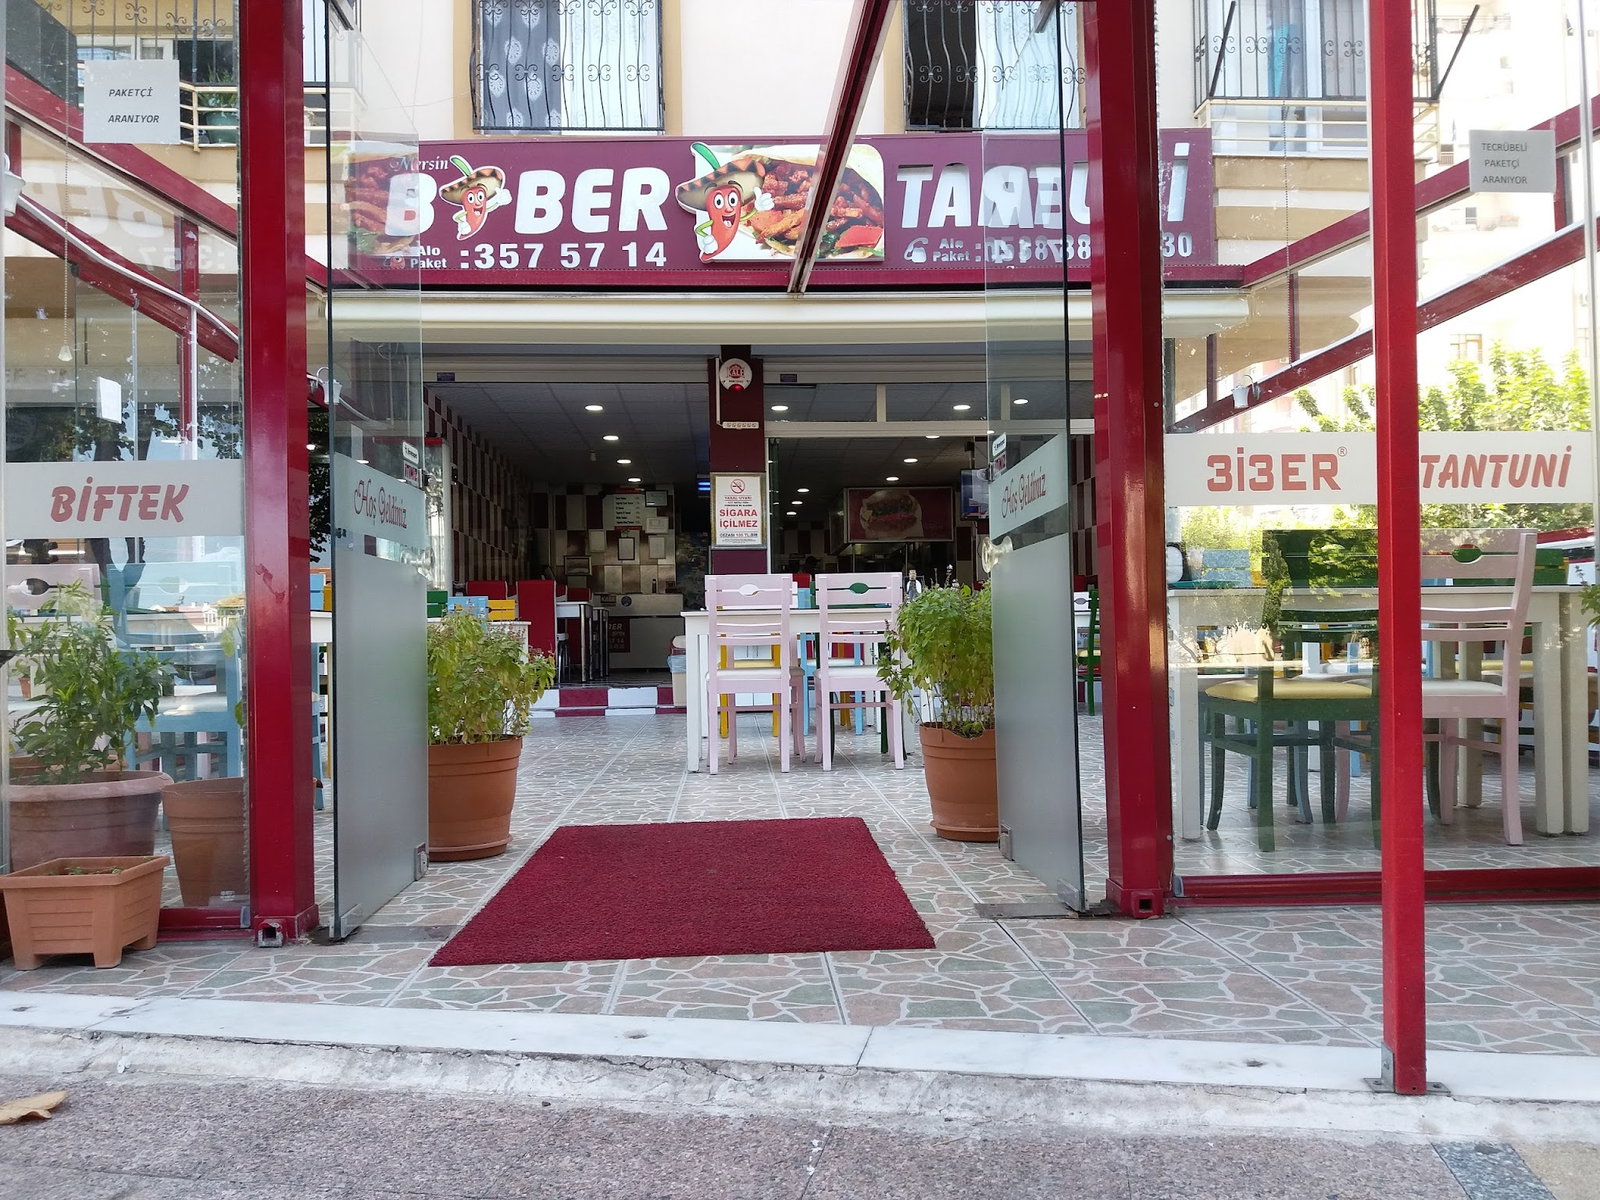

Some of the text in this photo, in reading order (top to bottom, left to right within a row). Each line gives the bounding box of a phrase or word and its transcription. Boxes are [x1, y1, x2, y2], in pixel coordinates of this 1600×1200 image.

[108, 85, 153, 98] PAKETÇİ
[107, 114, 160, 123] ARANIYOR
[1481, 141, 1528, 152] TECRÜBELİ
[388, 156, 449, 171] Mersin
[1484, 157, 1520, 169] PAKETÇİ
[1482, 175, 1528, 184] ARANIYOR
[939, 238, 963, 249] Alo
[417, 245, 441, 256] Alo
[560, 243, 605, 268] 57
[622, 242, 667, 267] 14
[933, 251, 970, 262] Paket
[410, 258, 447, 268] Paket
[1420, 444, 1572, 489] TANTUNİ
[50, 476, 190, 523] BİFTEK
[719, 508, 758, 517] SİGARA
[719, 519, 758, 530] İÇİLMEZ
